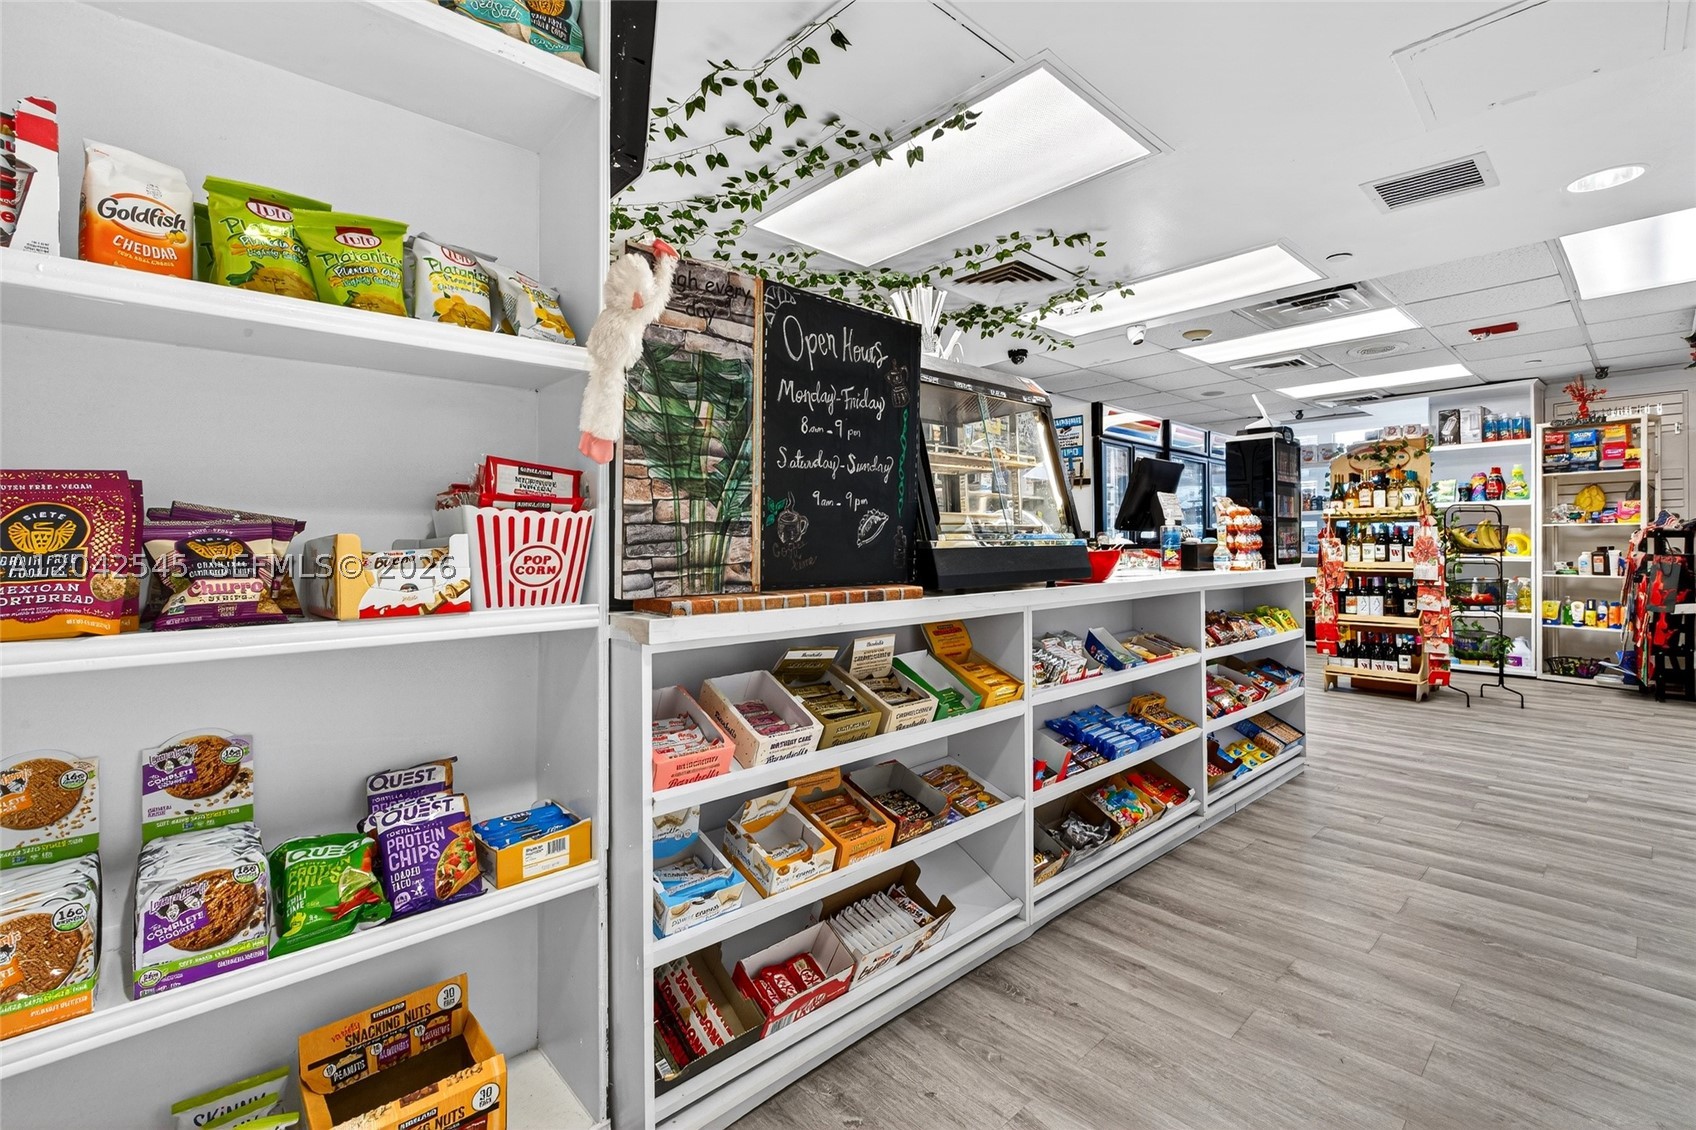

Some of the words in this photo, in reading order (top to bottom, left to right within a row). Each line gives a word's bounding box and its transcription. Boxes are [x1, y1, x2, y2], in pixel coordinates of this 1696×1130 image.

[97, 197, 186, 231] Goldfish
[112, 235, 178, 260] CHEDDAR
[705, 281, 751, 306] every
[685, 303, 716, 325] day
[782, 315, 838, 371] Open
[842, 326, 889, 369] Hours
[22, 511, 67, 521] SIETE
[515, 565, 556, 575] CORN
[523, 555, 552, 565] POP
[187, 580, 264, 598] Churro
[369, 767, 437, 792] QUEST
[381, 798, 454, 827] QUEST
[386, 826, 421, 839] TORTILLA
[386, 826, 446, 855] PROTEIN
[388, 842, 441, 872] CHIPS
[390, 866, 421, 883] LOADED
[392, 878, 412, 893] TACO
[146, 911, 205, 941] COMPLETE
[443, 986, 455, 1000] 30
[344, 1014, 400, 1048] SNACKING
[404, 1003, 431, 1024] NUTS
[333, 1059, 366, 1082] PEANUTS
[479, 1086, 492, 1100] 30
[434, 1105, 465, 1130] NUTS
